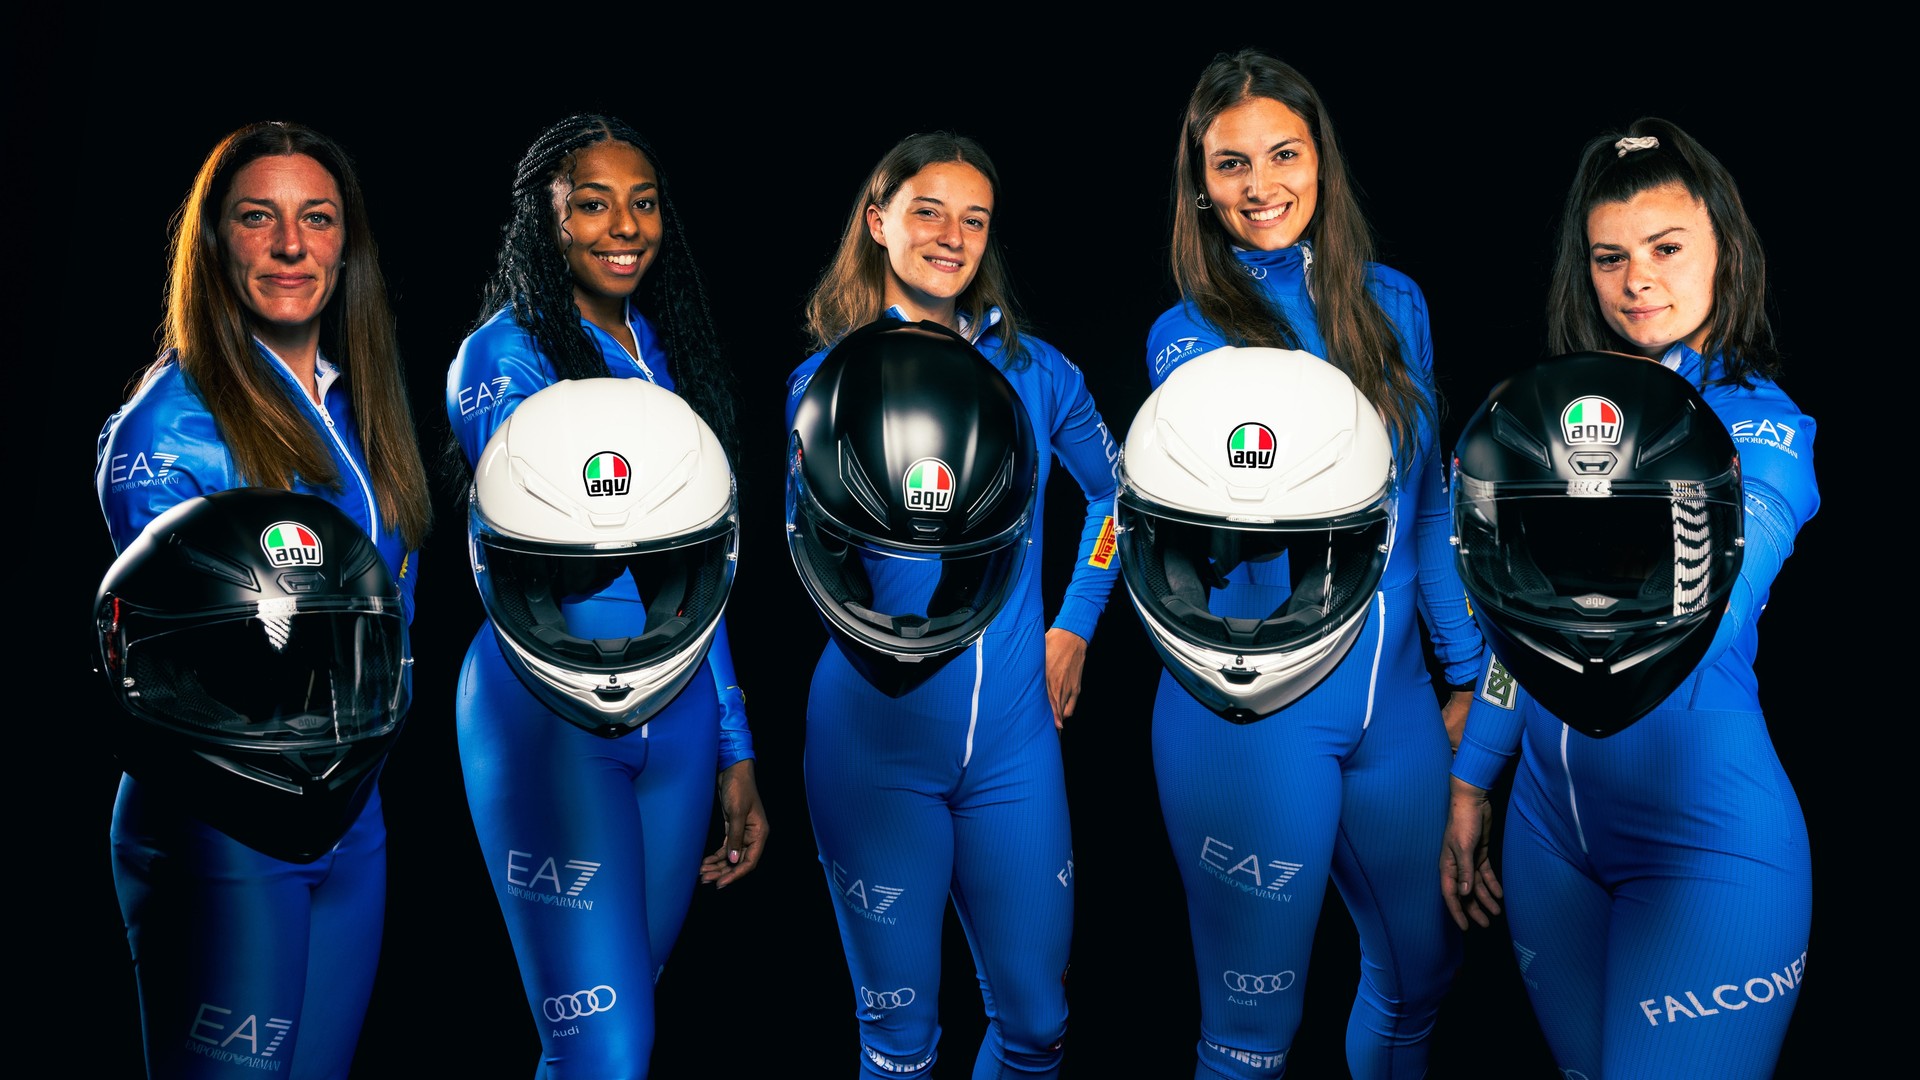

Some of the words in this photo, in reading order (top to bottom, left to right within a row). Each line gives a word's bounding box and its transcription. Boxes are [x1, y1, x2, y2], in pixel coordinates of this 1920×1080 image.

[458, 376, 512, 415] EA7
[1571, 424, 1615, 442] agv
[1731, 418, 1796, 447] EA7
[111, 451, 180, 484] EA7
[1233, 450, 1271, 468] agv
[590, 478, 627, 497] agv
[910, 490, 948, 511] agv
[1093, 517, 1116, 565] PIRE
[275, 547, 316, 565] agv
[1585, 597, 1606, 608] agv
[506, 849, 602, 897] EA7
[1200, 835, 1304, 891] EA7
[832, 860, 905, 914] EA7
[1198, 860, 1239, 888] EMPORIO
[1250, 888, 1293, 903] ARMANI
[507, 884, 541, 903] EMPORIO
[551, 895, 594, 911] ARMANI
[860, 910, 897, 926] ARMANI
[1227, 995, 1258, 1007] Audi
[190, 1003, 293, 1057] EA7
[552, 1025, 580, 1039] Audi
[184, 1040, 234, 1062] EMPORIO
[244, 1055, 282, 1072] ARMANI
